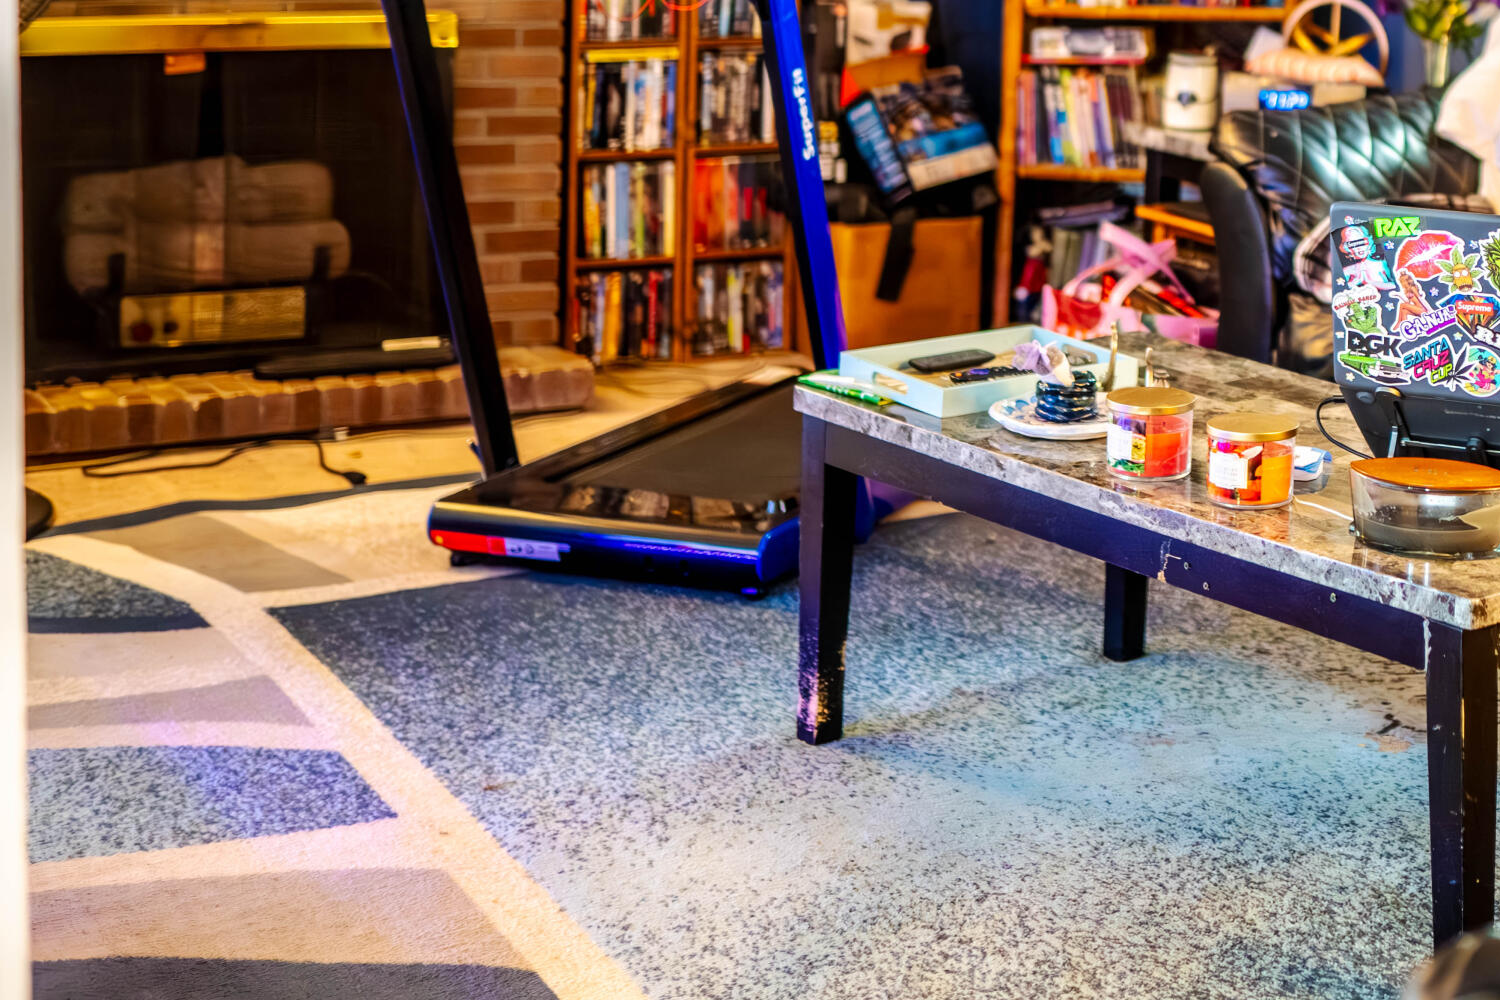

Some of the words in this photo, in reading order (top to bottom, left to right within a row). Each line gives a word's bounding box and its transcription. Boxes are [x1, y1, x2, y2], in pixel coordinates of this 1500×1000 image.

[1457, 301, 1493, 313] Supreme
[1347, 330, 1401, 359] DGK
[1403, 337, 1449, 370] SANTA
[1413, 350, 1450, 379] CRUZ
[1430, 363, 1453, 384] CUP
